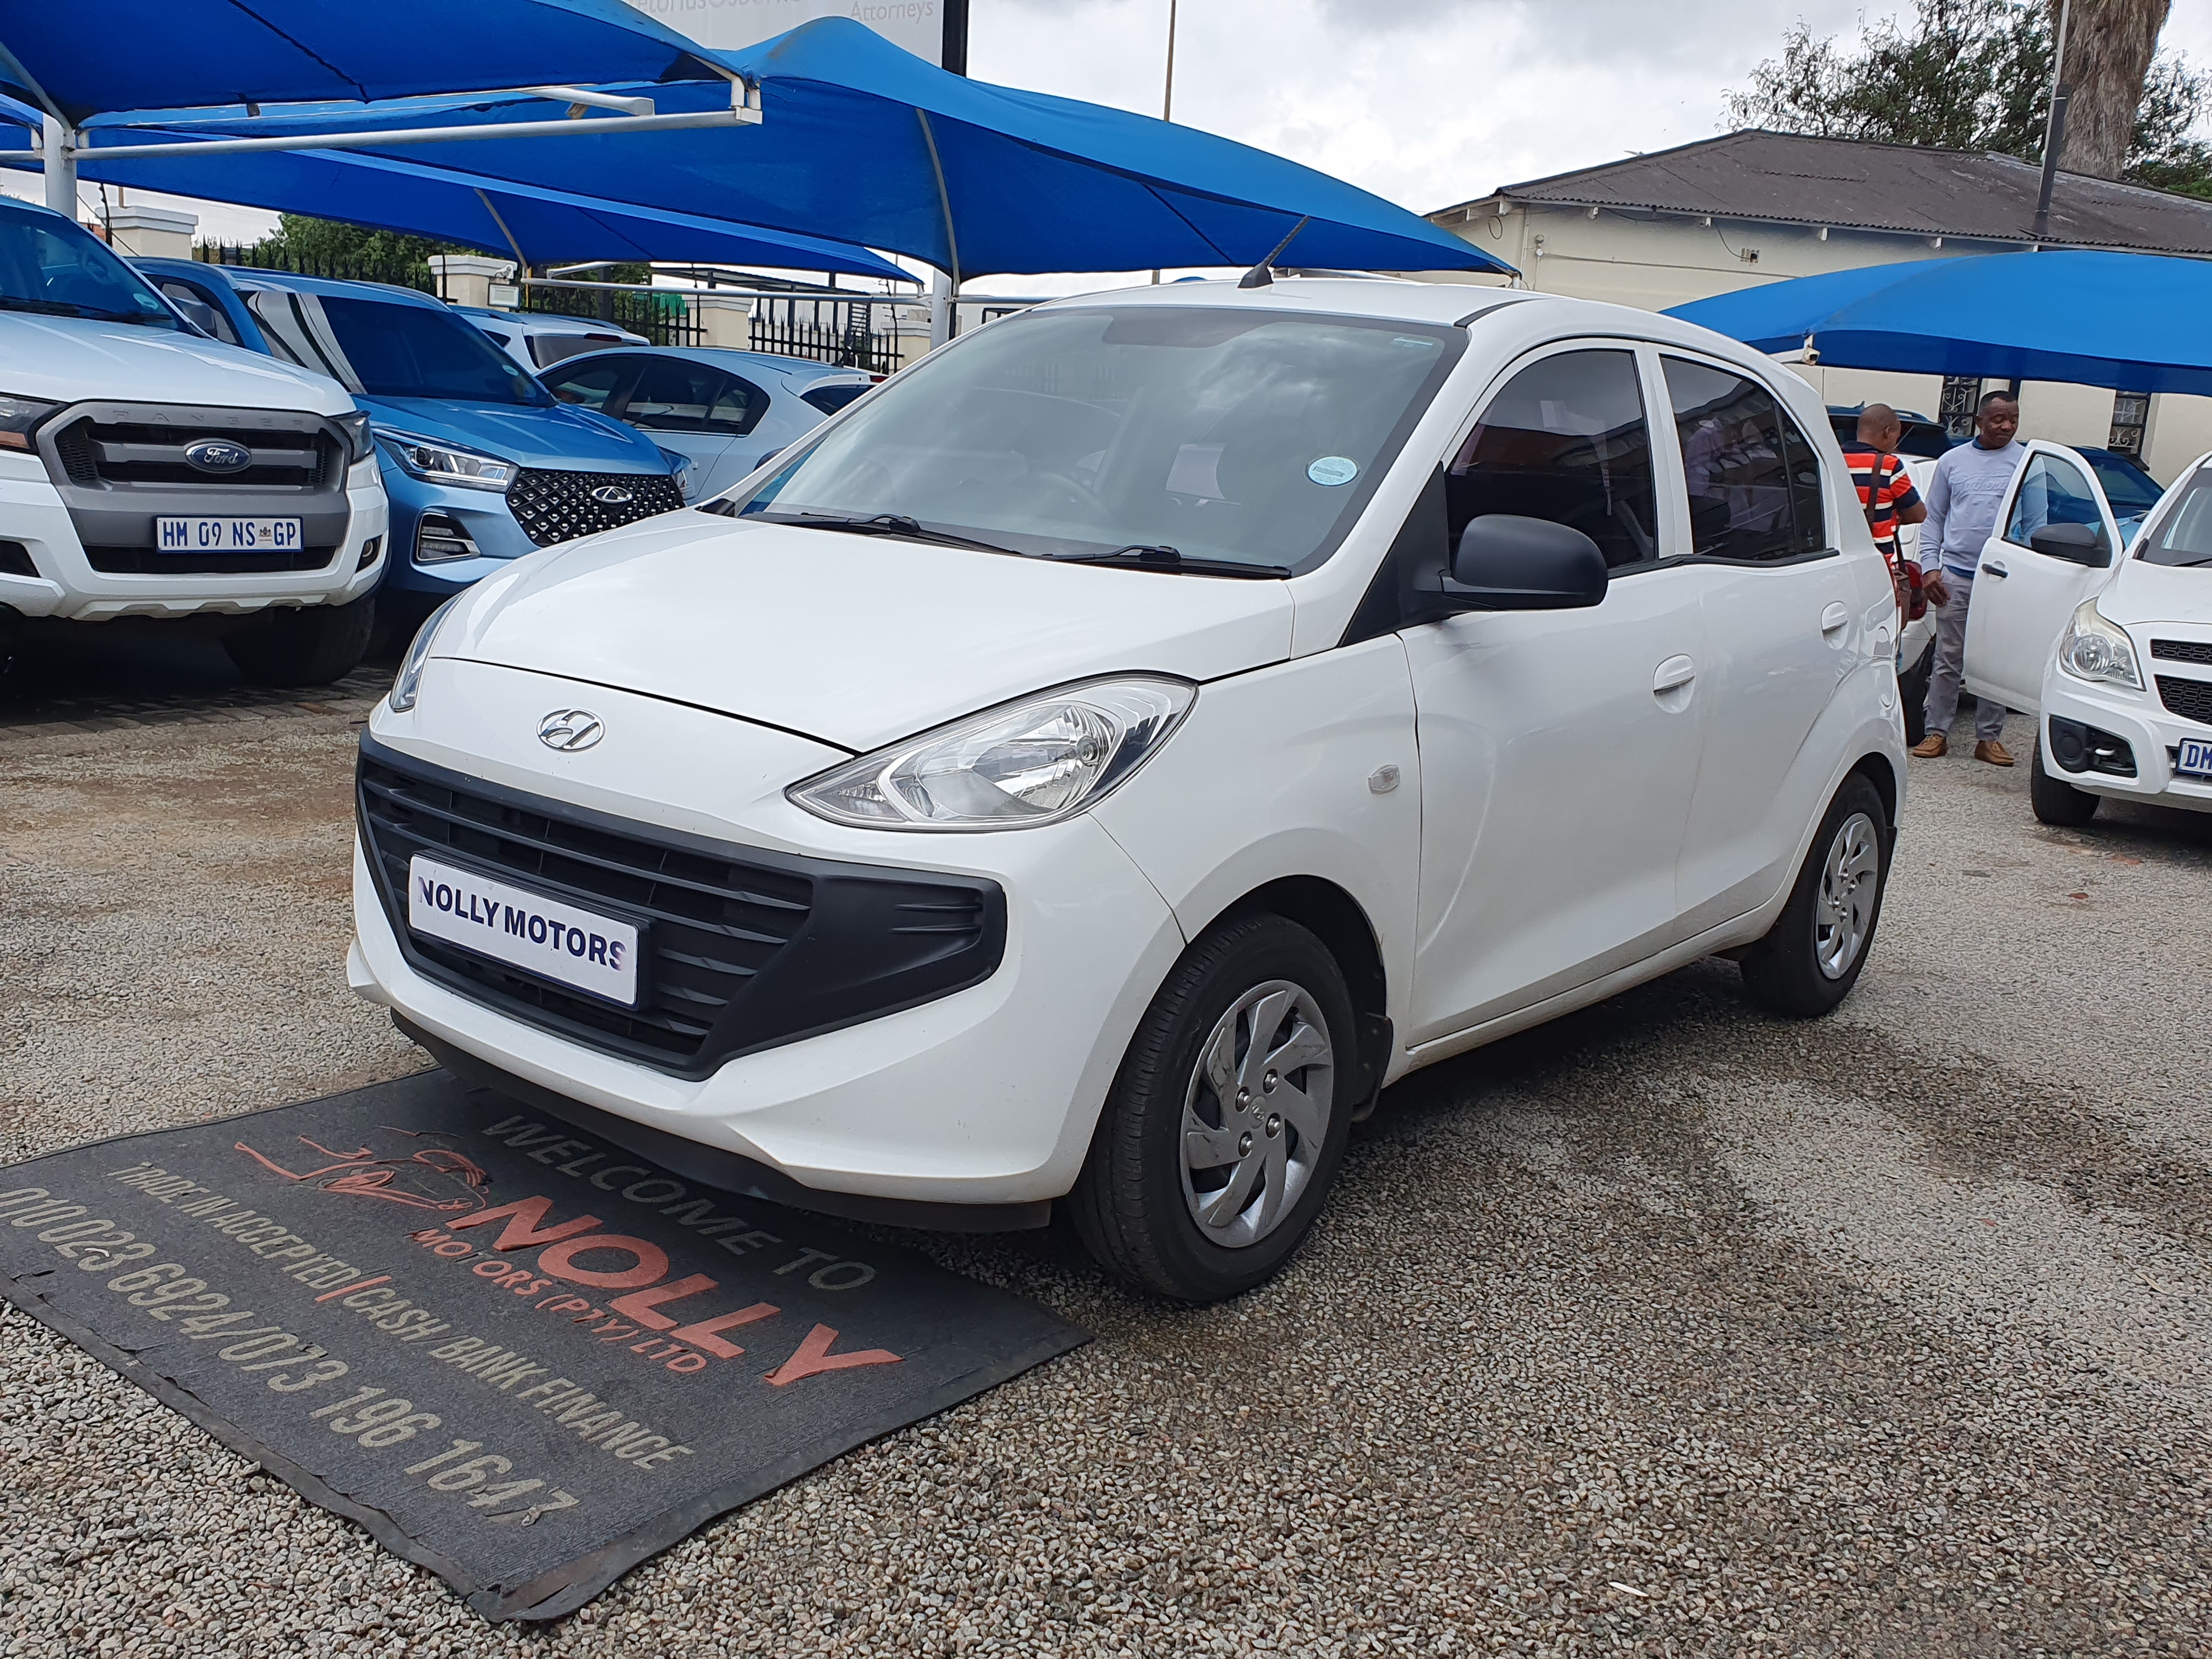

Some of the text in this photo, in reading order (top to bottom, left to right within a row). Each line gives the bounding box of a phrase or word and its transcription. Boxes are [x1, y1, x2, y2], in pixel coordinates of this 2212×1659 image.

[850, 1, 933, 25] Attorneys
[204, 447, 239, 465] Ford
[2184, 744, 2212, 770] DM
[418, 876, 627, 971] NOLLY MOTORS
[481, 1115, 876, 1290] WELCOME TO
[445, 1195, 905, 1387] NOLLY
[309, 1385, 442, 1447] 196
[515, 1377, 695, 1472] FINANCE
